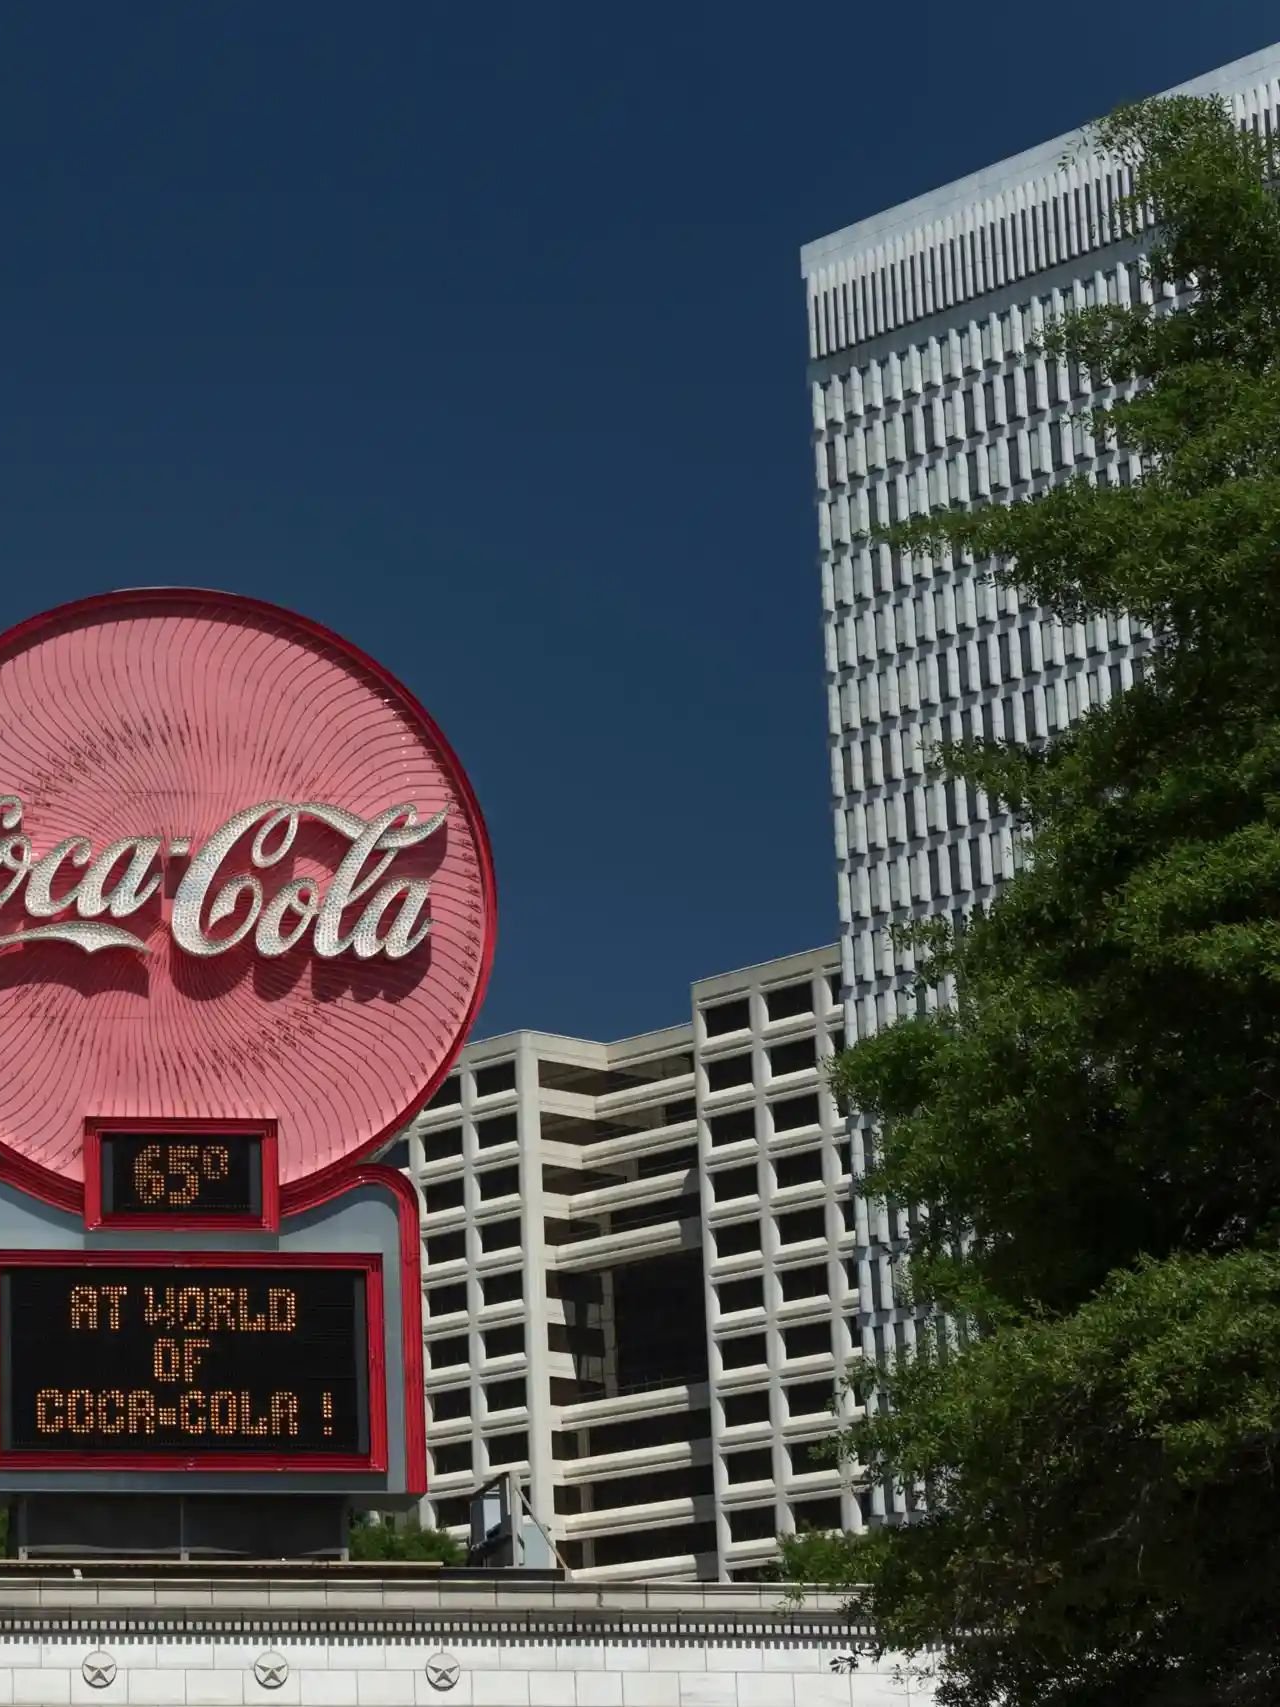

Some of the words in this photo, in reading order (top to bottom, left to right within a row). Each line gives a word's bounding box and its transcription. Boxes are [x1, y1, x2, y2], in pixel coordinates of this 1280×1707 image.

[70, 1286, 127, 1330] AT
[144, 1286, 296, 1332] WORLD
[152, 1338, 211, 1383] OF
[36, 1389, 299, 1436] COCA-COLA
[322, 1391, 333, 1436] !
